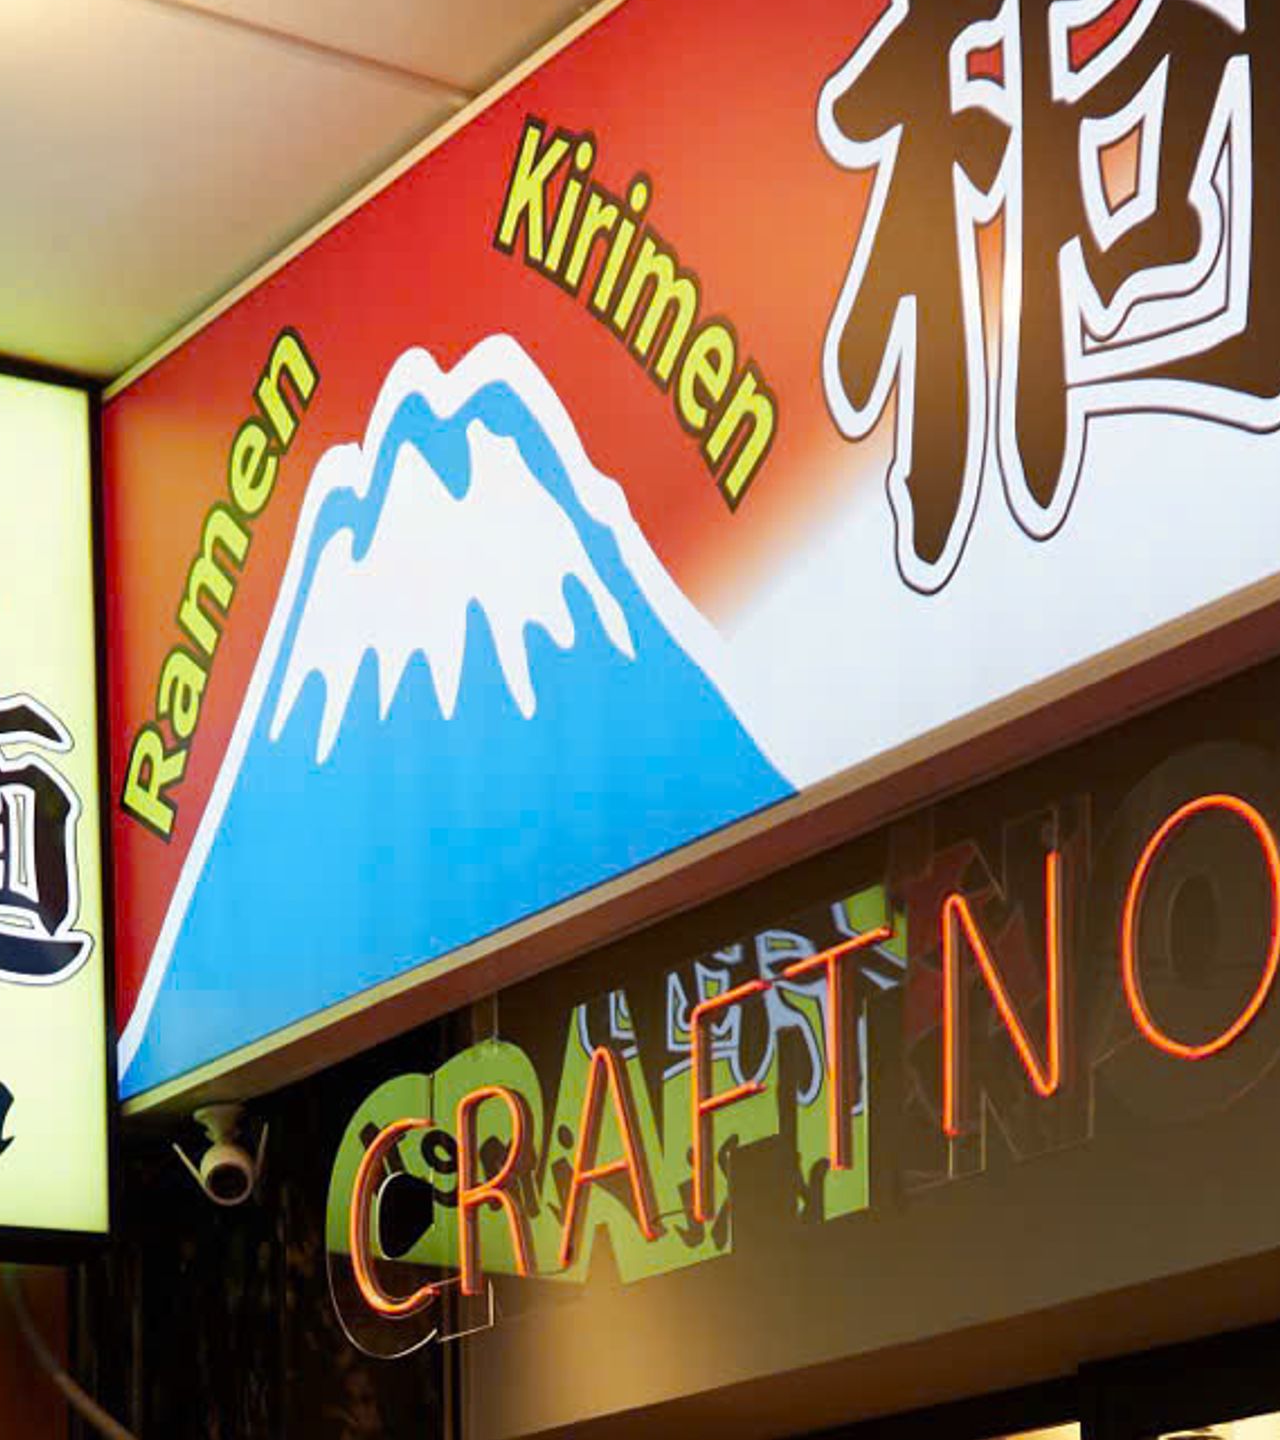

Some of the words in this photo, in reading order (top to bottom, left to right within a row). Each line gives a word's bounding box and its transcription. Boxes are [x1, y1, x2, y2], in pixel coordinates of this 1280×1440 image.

[122, 327, 319, 841] Ramen
[492, 115, 778, 512] Kirimen
[350, 924, 894, 1312] CRAFT
